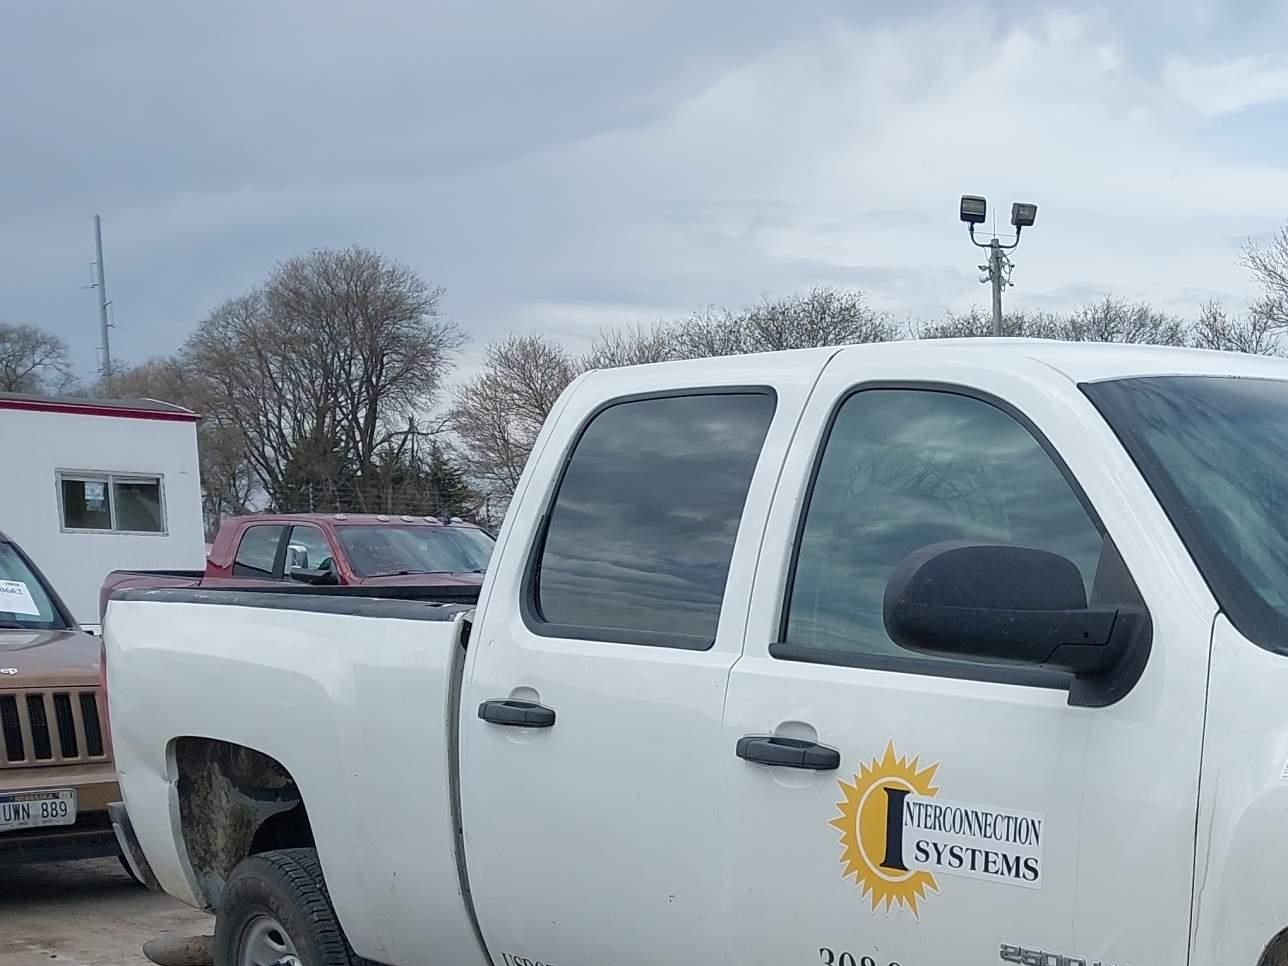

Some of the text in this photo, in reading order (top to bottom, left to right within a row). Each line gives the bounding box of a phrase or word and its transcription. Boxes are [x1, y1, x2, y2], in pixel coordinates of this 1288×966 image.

[3, 801, 67, 822] UWN 889
[879, 786, 1042, 872] INTERCONNECTION
[914, 839, 1040, 882] SYSTEMS
